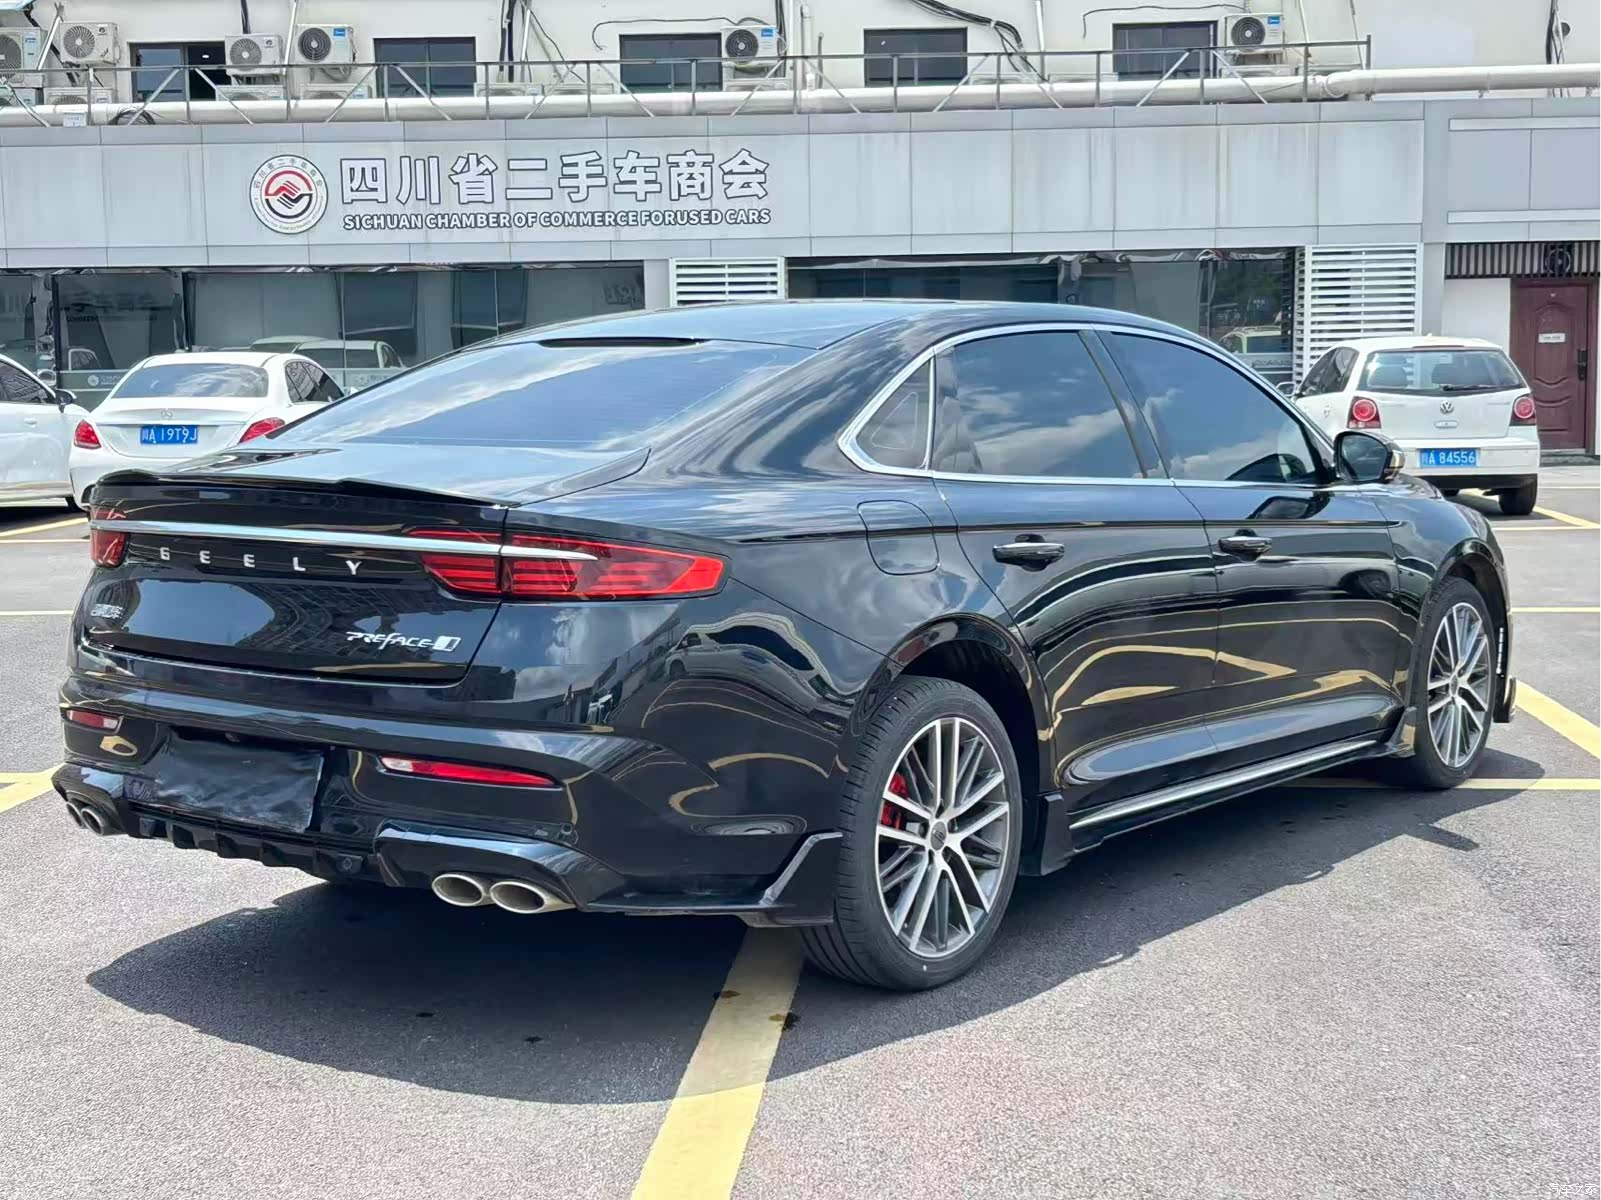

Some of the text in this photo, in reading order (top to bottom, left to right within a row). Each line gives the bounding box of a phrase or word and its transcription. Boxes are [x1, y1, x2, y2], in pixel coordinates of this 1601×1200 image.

[340, 148, 769, 205] 四川省二手车商会
[343, 213, 423, 231] SICHUAN
[424, 212, 511, 230] CHAMBER
[513, 212, 539, 228] OF
[539, 211, 638, 228] COMMERCE
[725, 208, 771, 225] CARS
[159, 547, 362, 575] GEELY
